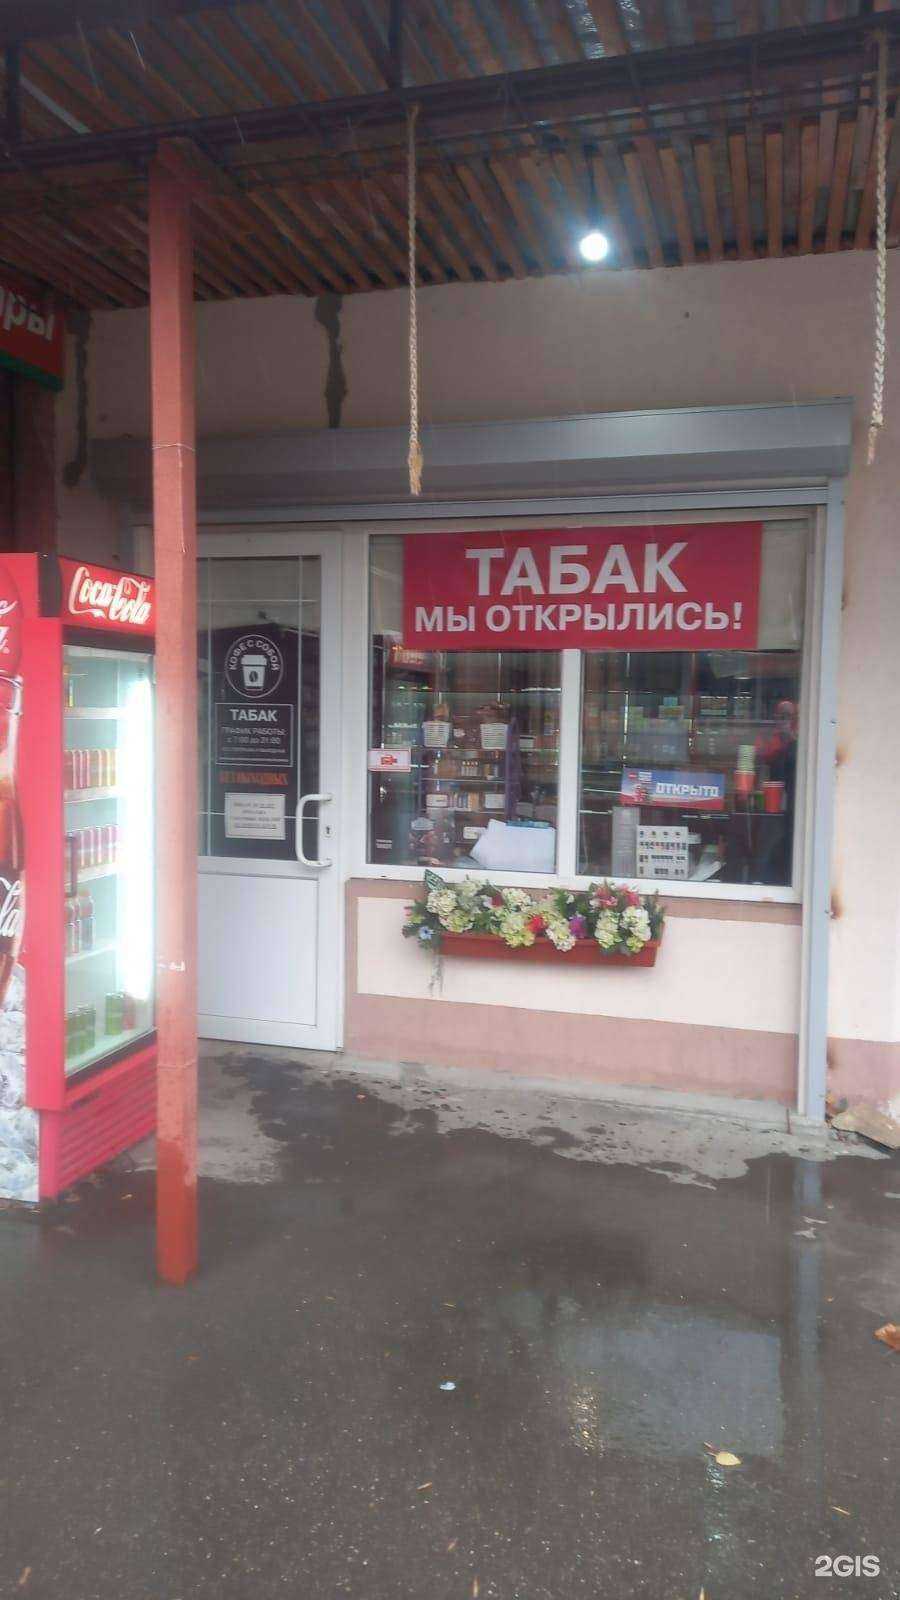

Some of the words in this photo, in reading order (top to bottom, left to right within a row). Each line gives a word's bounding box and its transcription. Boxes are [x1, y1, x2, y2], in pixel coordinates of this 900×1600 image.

[0, 286, 55, 341] ры
[465, 541, 688, 596] ТАБАК
[414, 604, 475, 633] МЫ
[485, 600, 744, 632] ОТКРЫЛИСЬ!
[228, 641, 248, 671] КОФЕ
[255, 640, 281, 671] СОБОЙ
[229, 708, 278, 722] ТАБАК
[655, 782, 719, 797] ОТКРЫТО
